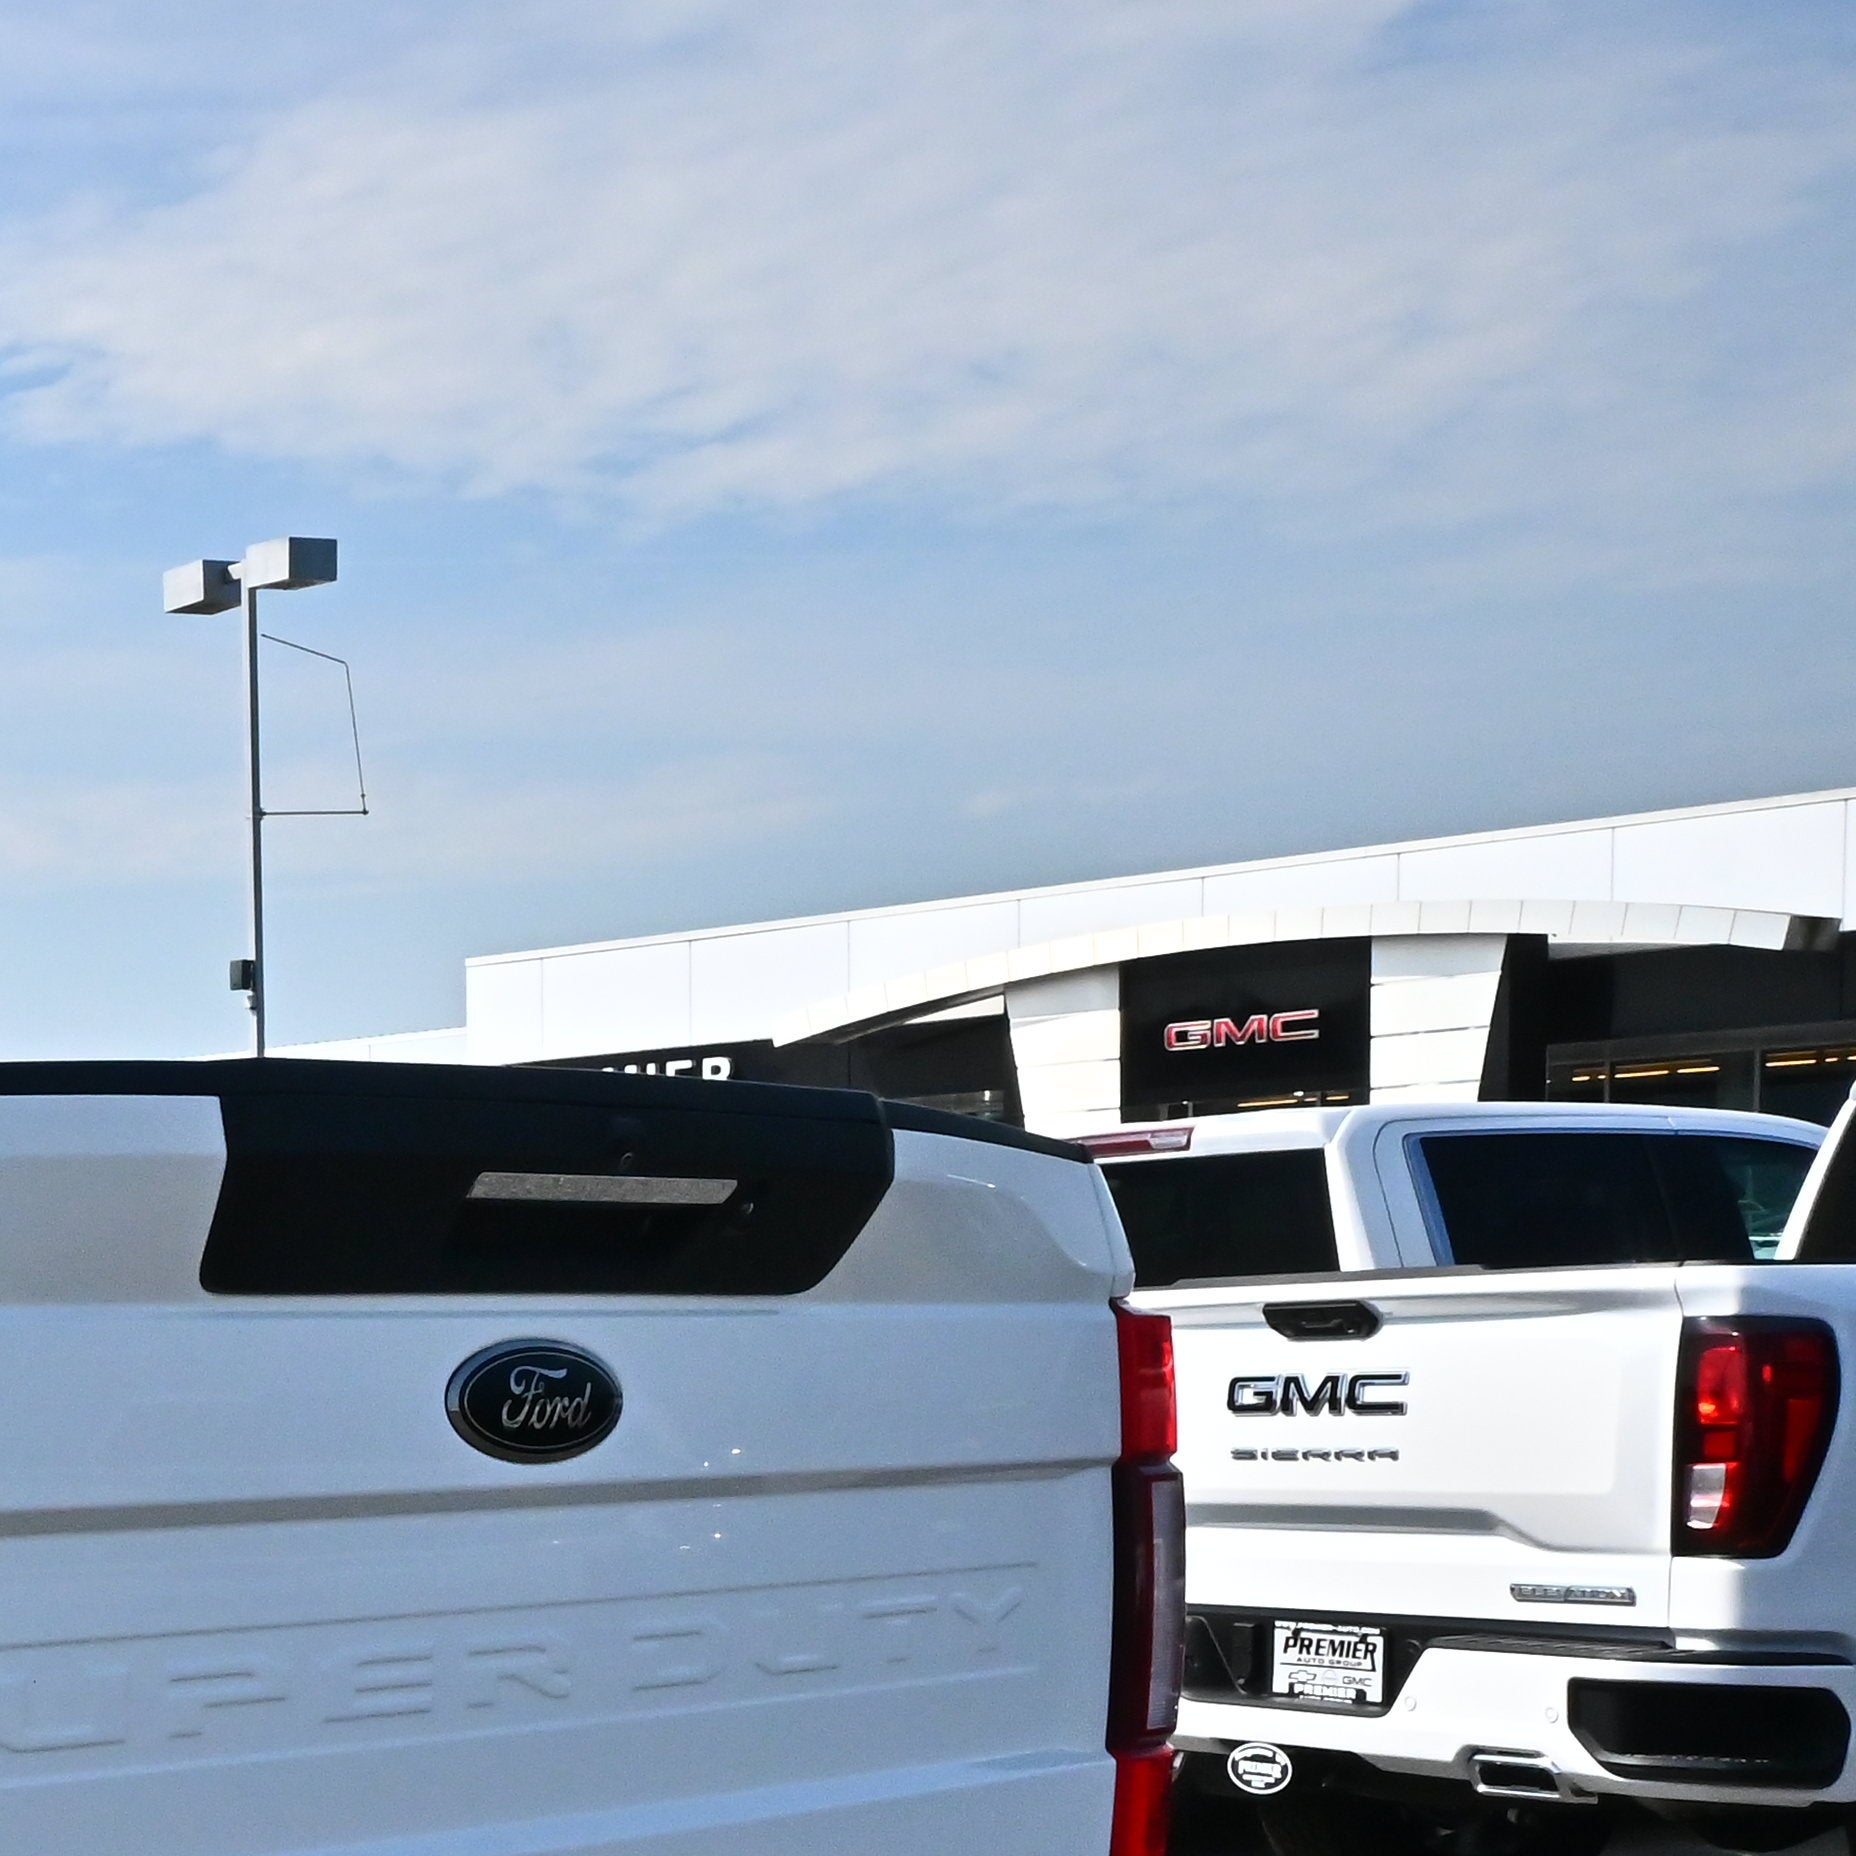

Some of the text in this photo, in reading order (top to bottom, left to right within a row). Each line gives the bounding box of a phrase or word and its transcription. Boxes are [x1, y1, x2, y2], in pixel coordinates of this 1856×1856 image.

[1164, 1009, 1320, 1051] GMC
[501, 1365, 591, 1429] Ford
[1227, 1371, 1409, 1417] GMC
[1231, 1447, 1399, 1461] SIERRA
[630, 1584, 1024, 1694] DUTY
[1283, 1635, 1377, 1665] PREMIER
[1297, 1657, 1325, 1665] AUTO
[1342, 1675, 1373, 1687] GMC
